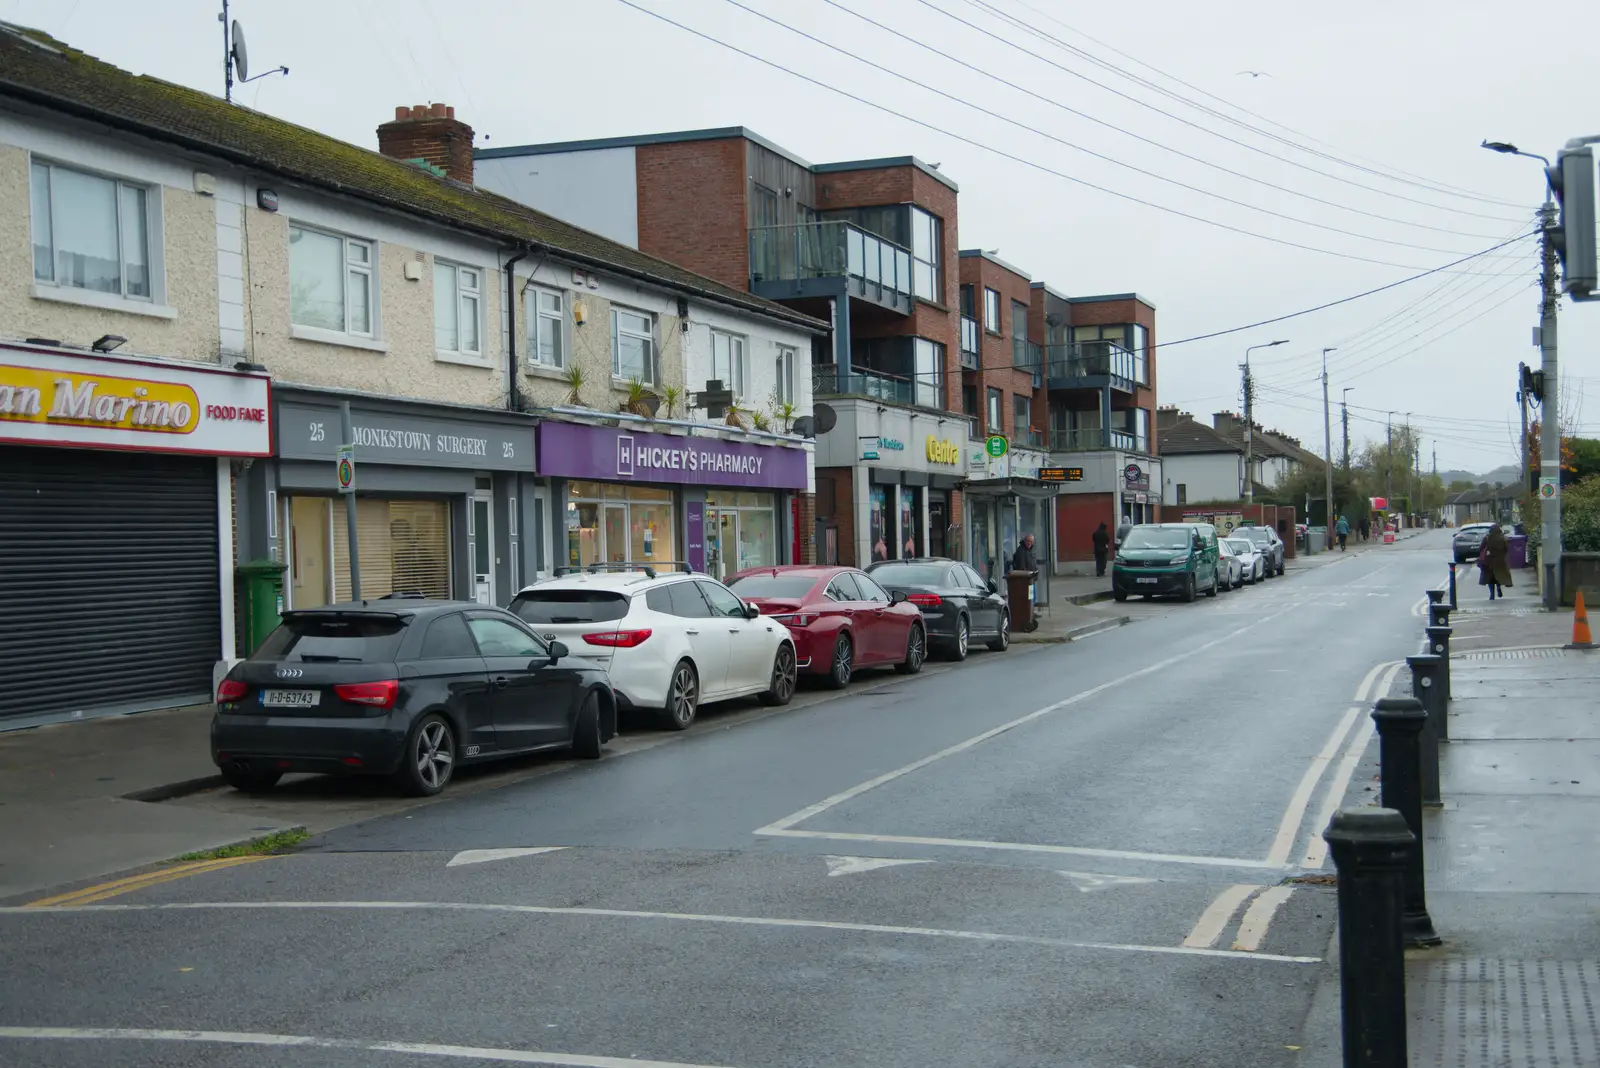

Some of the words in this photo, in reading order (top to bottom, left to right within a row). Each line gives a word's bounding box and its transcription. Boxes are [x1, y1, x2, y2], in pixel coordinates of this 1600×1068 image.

[48, 379, 192, 429] Marino
[207, 405, 237, 420] FOOD
[238, 407, 266, 422] FARE
[310, 422, 325, 442] 25
[351, 426, 431, 451] MONKSTOWN
[437, 434, 488, 456] SURGERY
[502, 442, 515, 459] 25
[926, 434, 959, 465] Centra
[637, 446, 698, 471] HICKEY'S
[700, 451, 763, 475] PHARMACY
[269, 691, 313, 704] 11-D-63743
